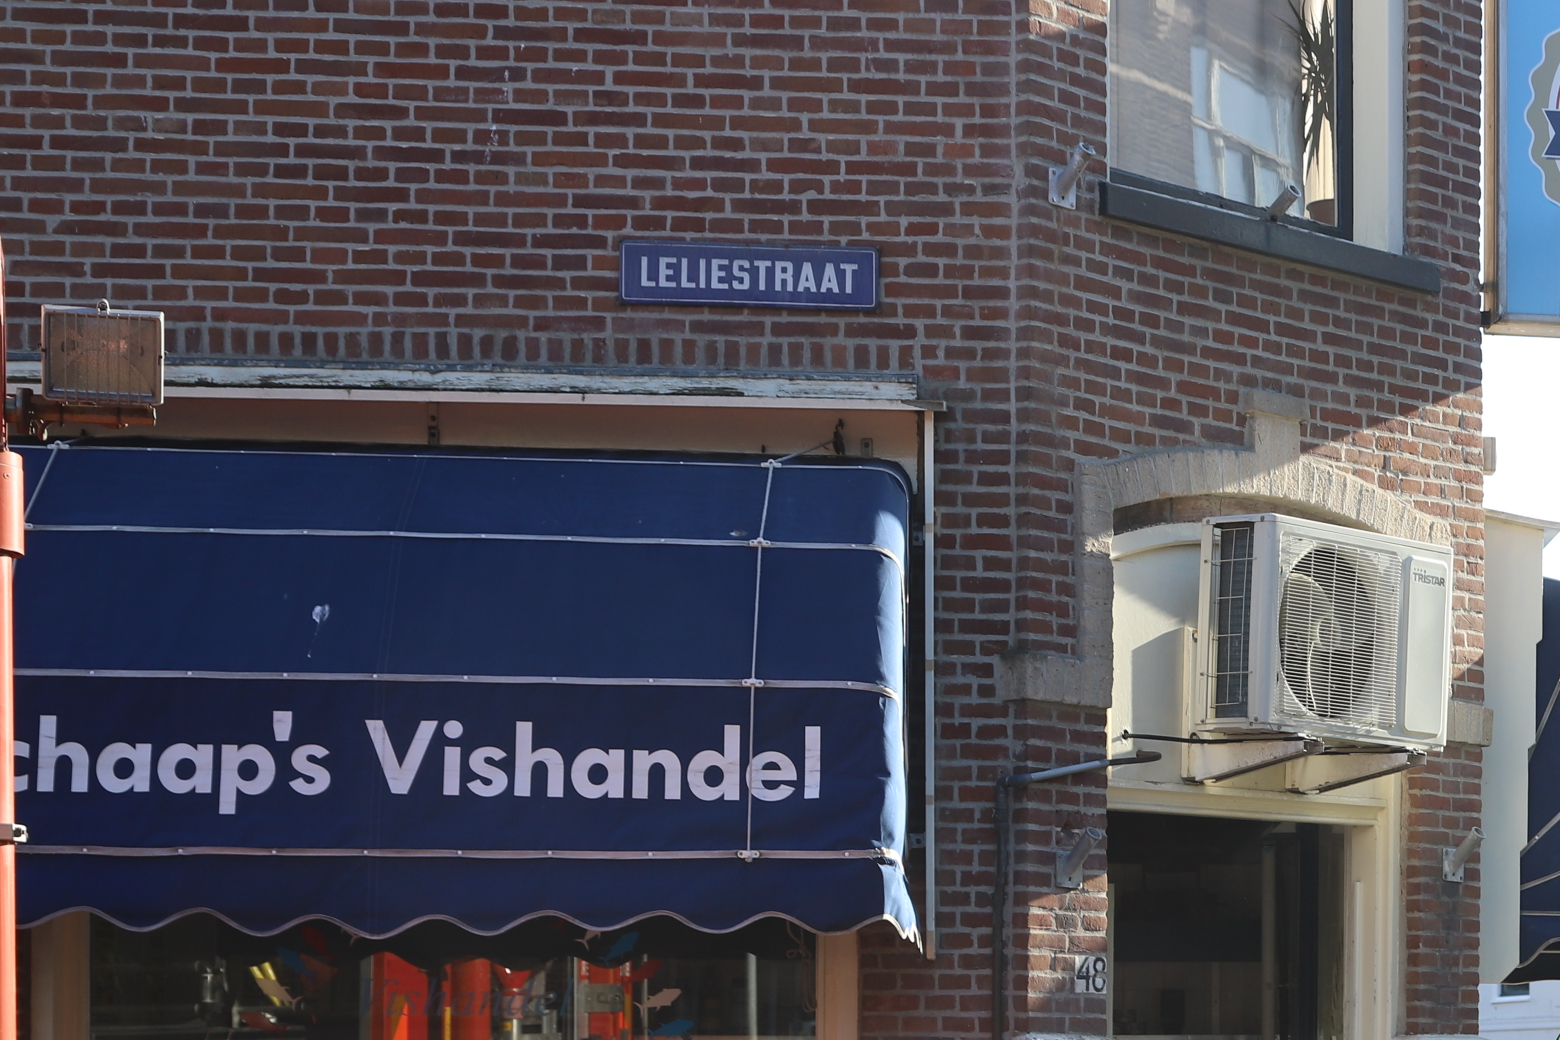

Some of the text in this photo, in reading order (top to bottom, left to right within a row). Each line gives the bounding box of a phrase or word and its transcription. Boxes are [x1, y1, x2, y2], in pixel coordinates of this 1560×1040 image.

[640, 255, 859, 294] LELIESTRAAT
[1412, 569, 1446, 587] TRISTAR
[364, 718, 822, 801] Vishandel
[1076, 956, 1107, 992] 48
